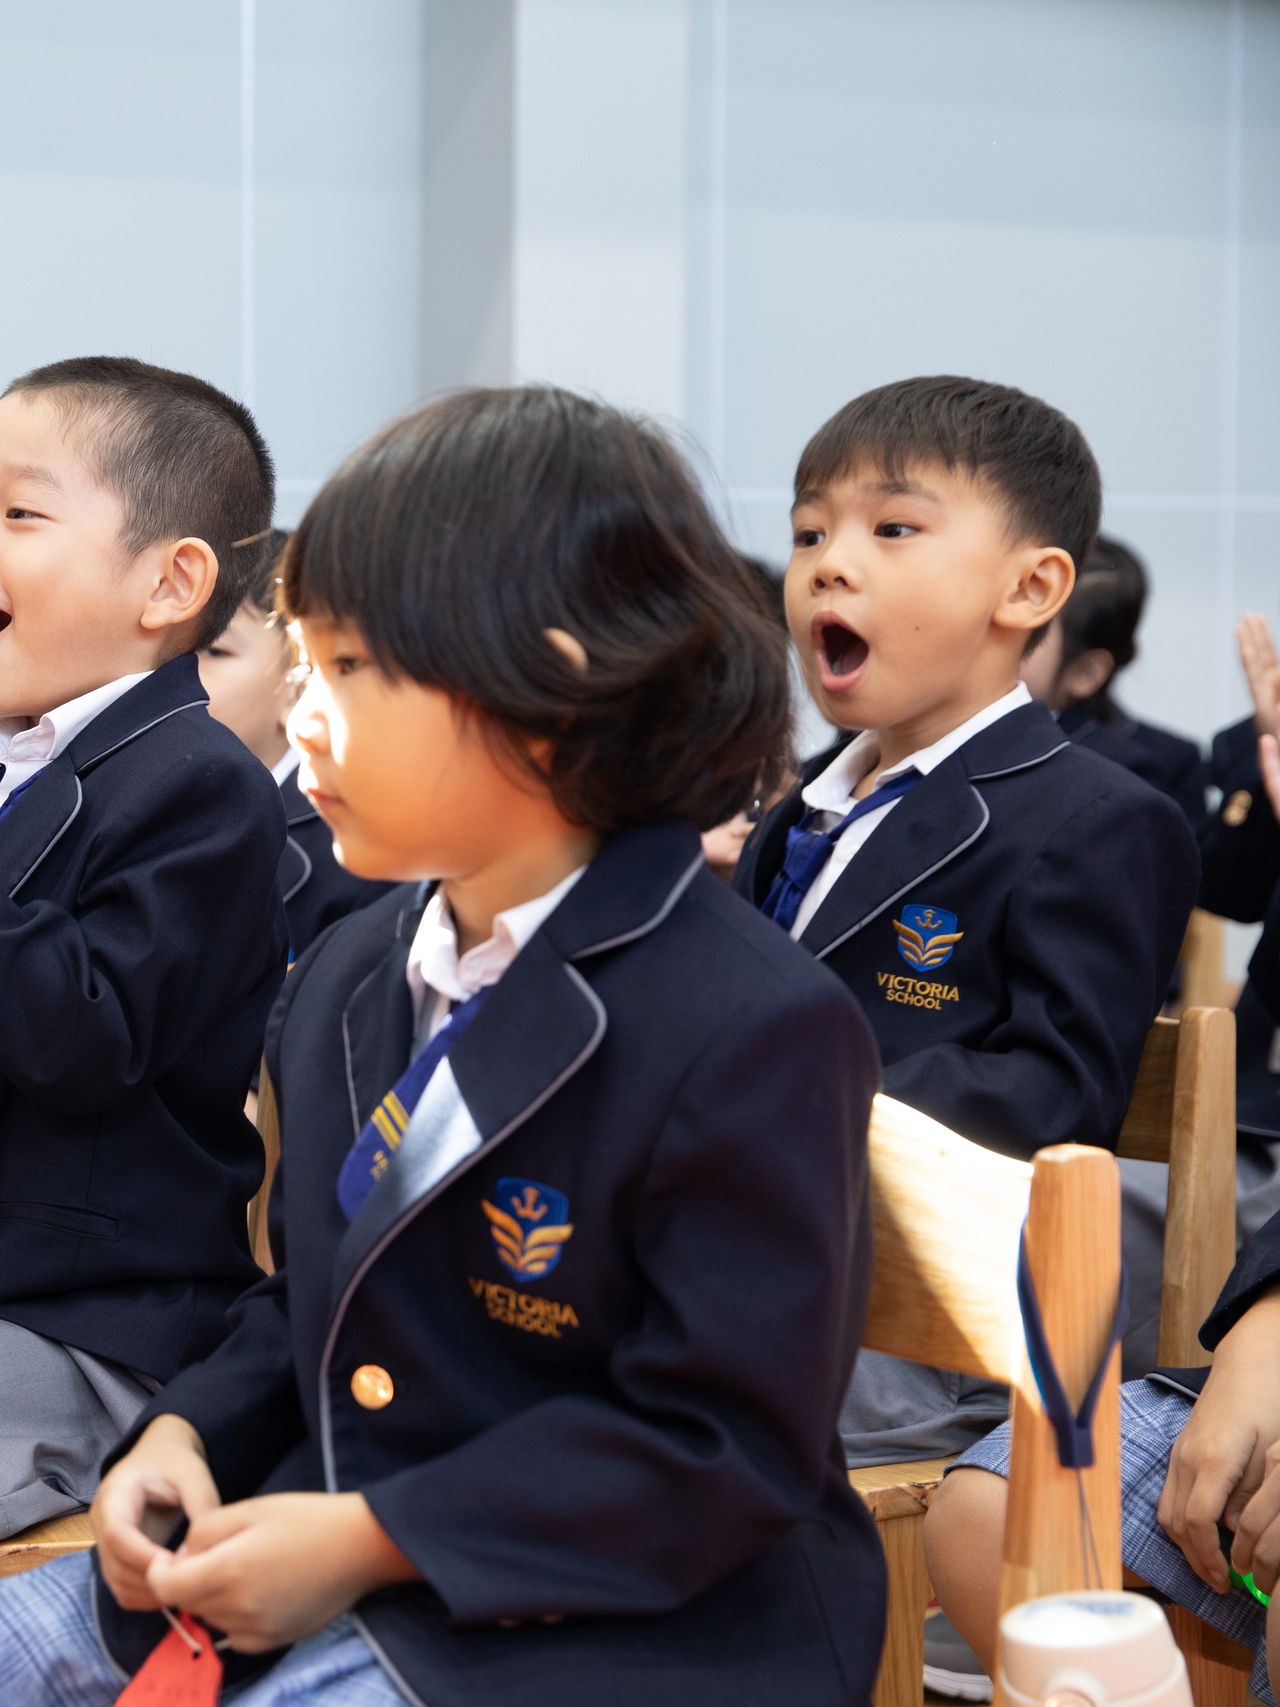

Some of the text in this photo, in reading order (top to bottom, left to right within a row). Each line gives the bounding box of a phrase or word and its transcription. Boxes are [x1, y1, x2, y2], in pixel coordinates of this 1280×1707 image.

[876, 971, 960, 1002] VICTORIA
[885, 989, 942, 1011] SCHOOL
[468, 1276, 580, 1328] VICTORIA
